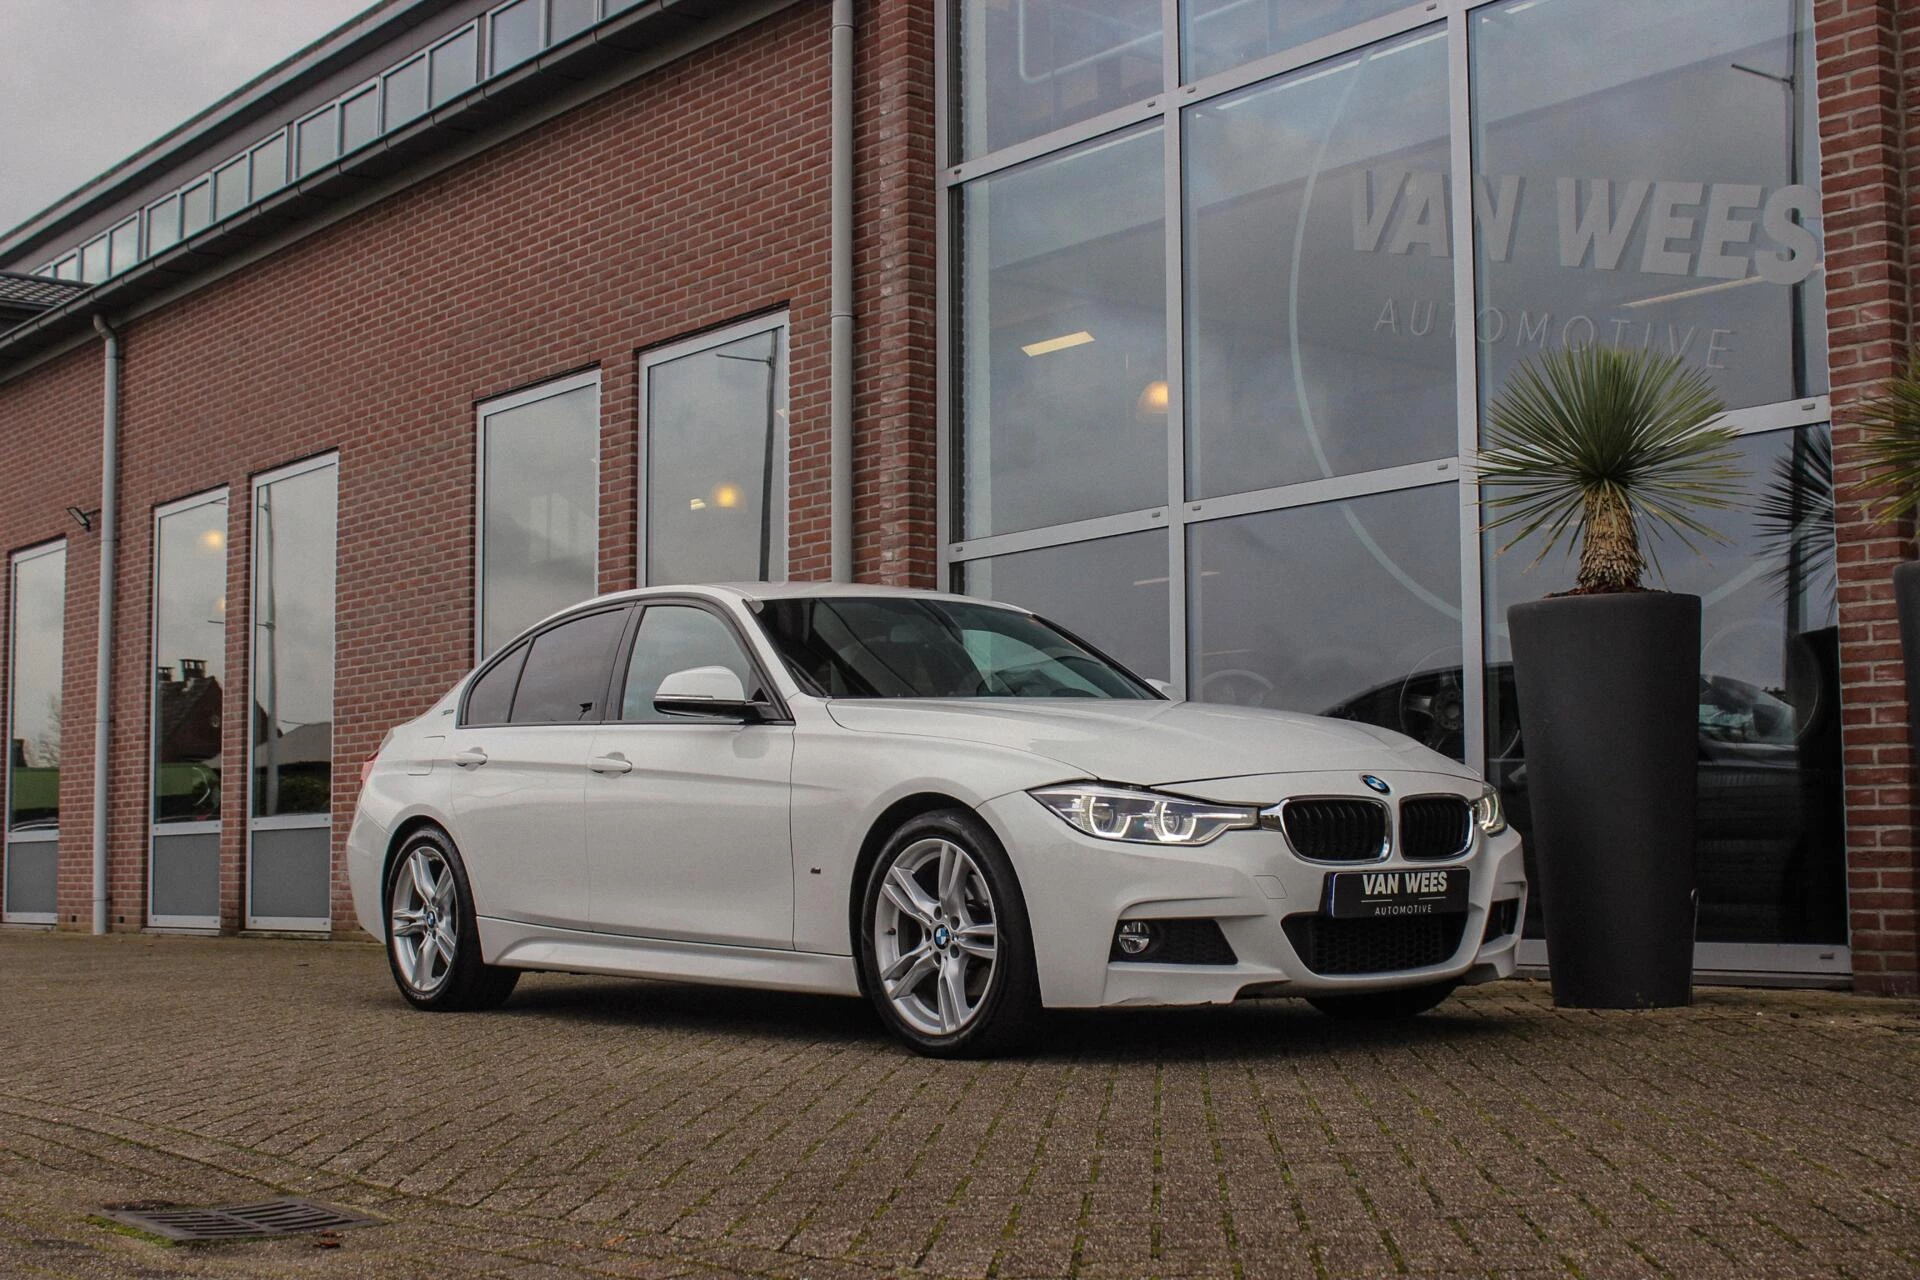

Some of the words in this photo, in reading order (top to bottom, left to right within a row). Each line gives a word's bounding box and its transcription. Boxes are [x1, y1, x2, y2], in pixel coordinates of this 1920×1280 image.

[1350, 169, 1523, 263] VAN
[1555, 176, 1822, 285] WEES
[1362, 873, 1399, 895] VAN
[1405, 871, 1448, 893] WEES
[1374, 904, 1432, 916] AUTOMOTIVE
